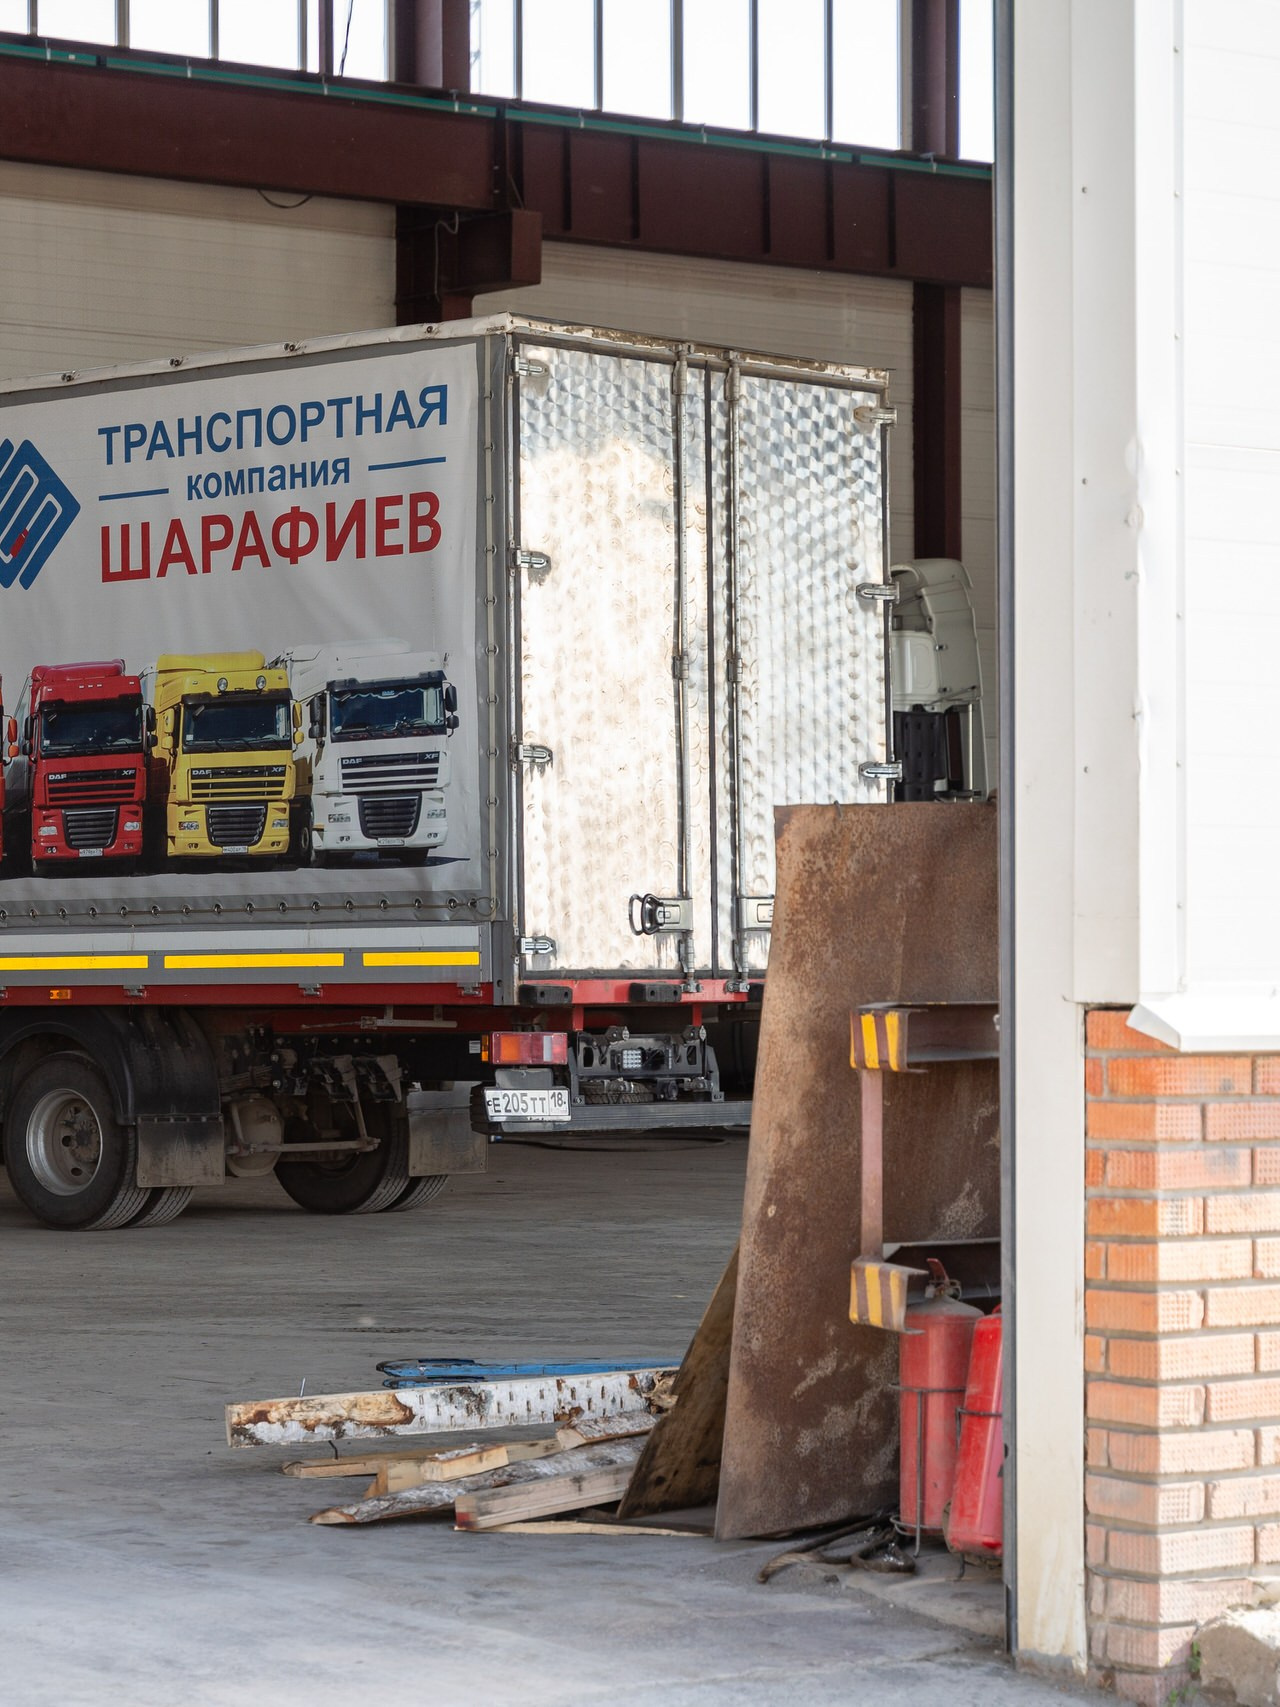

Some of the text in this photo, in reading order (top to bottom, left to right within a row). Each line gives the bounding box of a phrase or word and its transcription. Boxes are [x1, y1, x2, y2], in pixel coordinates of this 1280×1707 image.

[97, 384, 448, 465] ТРАНСПОРТНАЯ
[187, 457, 350, 501] компания
[101, 491, 442, 583] ШАРАФИЕВ
[342, 752, 439, 765] DAF XF
